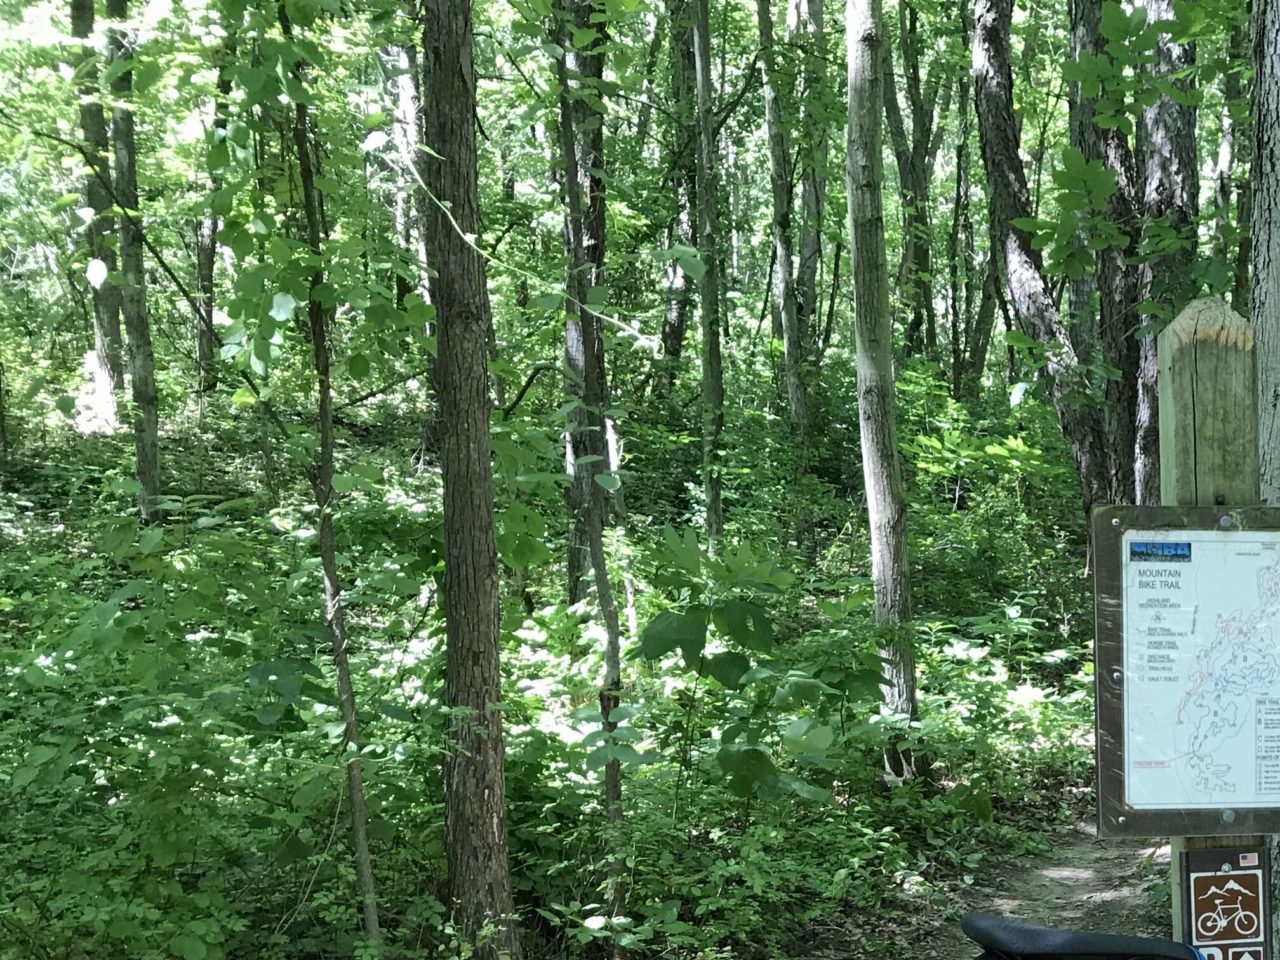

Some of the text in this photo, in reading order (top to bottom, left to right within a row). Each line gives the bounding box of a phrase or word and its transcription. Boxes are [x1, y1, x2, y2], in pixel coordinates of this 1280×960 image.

[1138, 569, 1181, 578] MOUNTAIN
[1138, 580, 1182, 589] BIKE TRAIL
